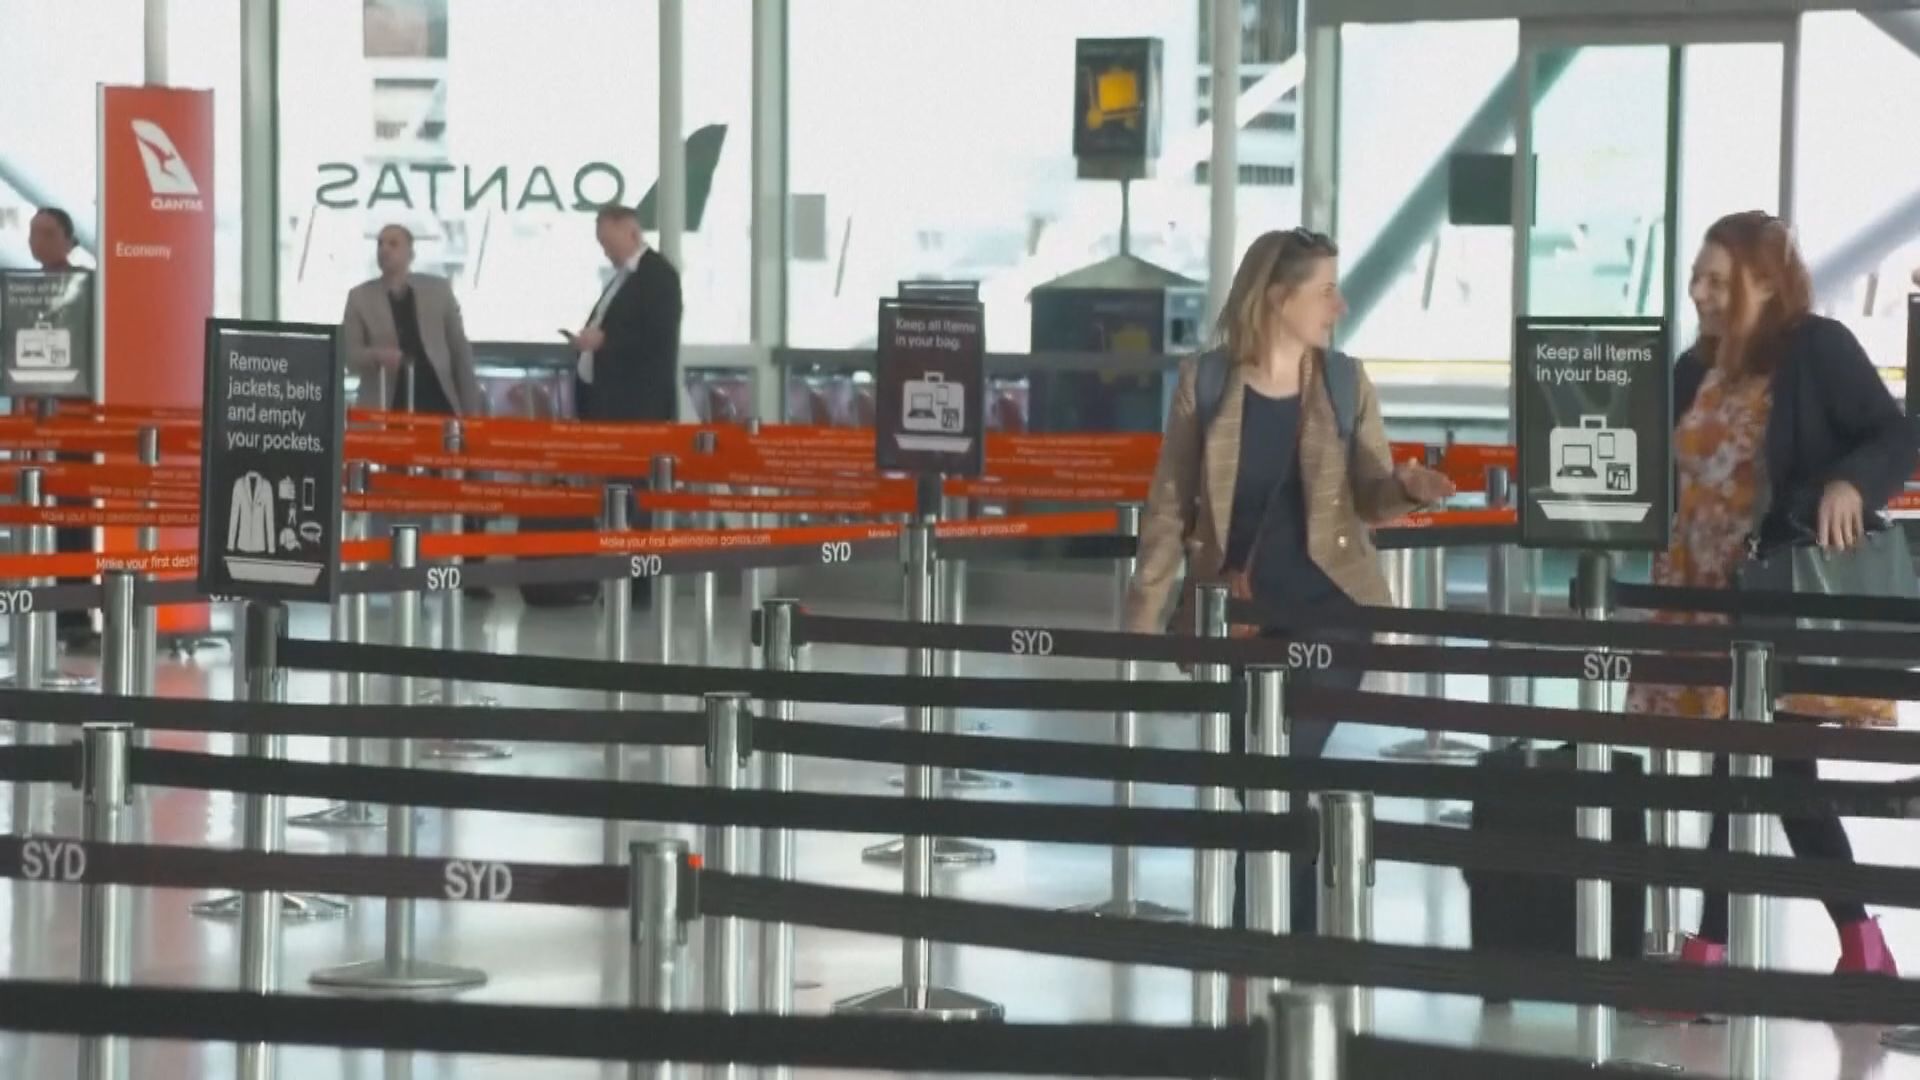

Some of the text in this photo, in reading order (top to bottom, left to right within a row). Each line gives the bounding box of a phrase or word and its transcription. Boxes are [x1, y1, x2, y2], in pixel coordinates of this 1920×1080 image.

[151, 198, 203, 211] QANTAS
[115, 242, 172, 260] Economy
[896, 318, 926, 333] Keep
[928, 319, 941, 332] all
[896, 335, 906, 346] in
[908, 337, 933, 349] your
[1536, 343, 1652, 364] Keep all items
[230, 349, 289, 374] Remove
[1536, 363, 1552, 382] in
[1554, 367, 1592, 386] your
[227, 375, 322, 401] jackets, belts
[228, 402, 306, 431] and empty
[227, 431, 260, 451] your
[263, 431, 324, 453] pockets.
[600, 536, 625, 548] Make
[627, 537, 646, 550] your
[649, 534, 666, 547] first
[667, 534, 718, 548] destination
[822, 541, 851, 564] SYD
[96, 557, 124, 570] Make
[126, 558, 149, 570] your
[151, 555, 170, 568] first
[631, 555, 662, 578] SYD
[427, 567, 461, 590] SYD
[1011, 629, 1053, 656] SYD
[1288, 642, 1332, 669] SYD
[1584, 653, 1632, 680] SYD
[21, 841, 86, 880] SYD
[444, 860, 513, 900] SYD
